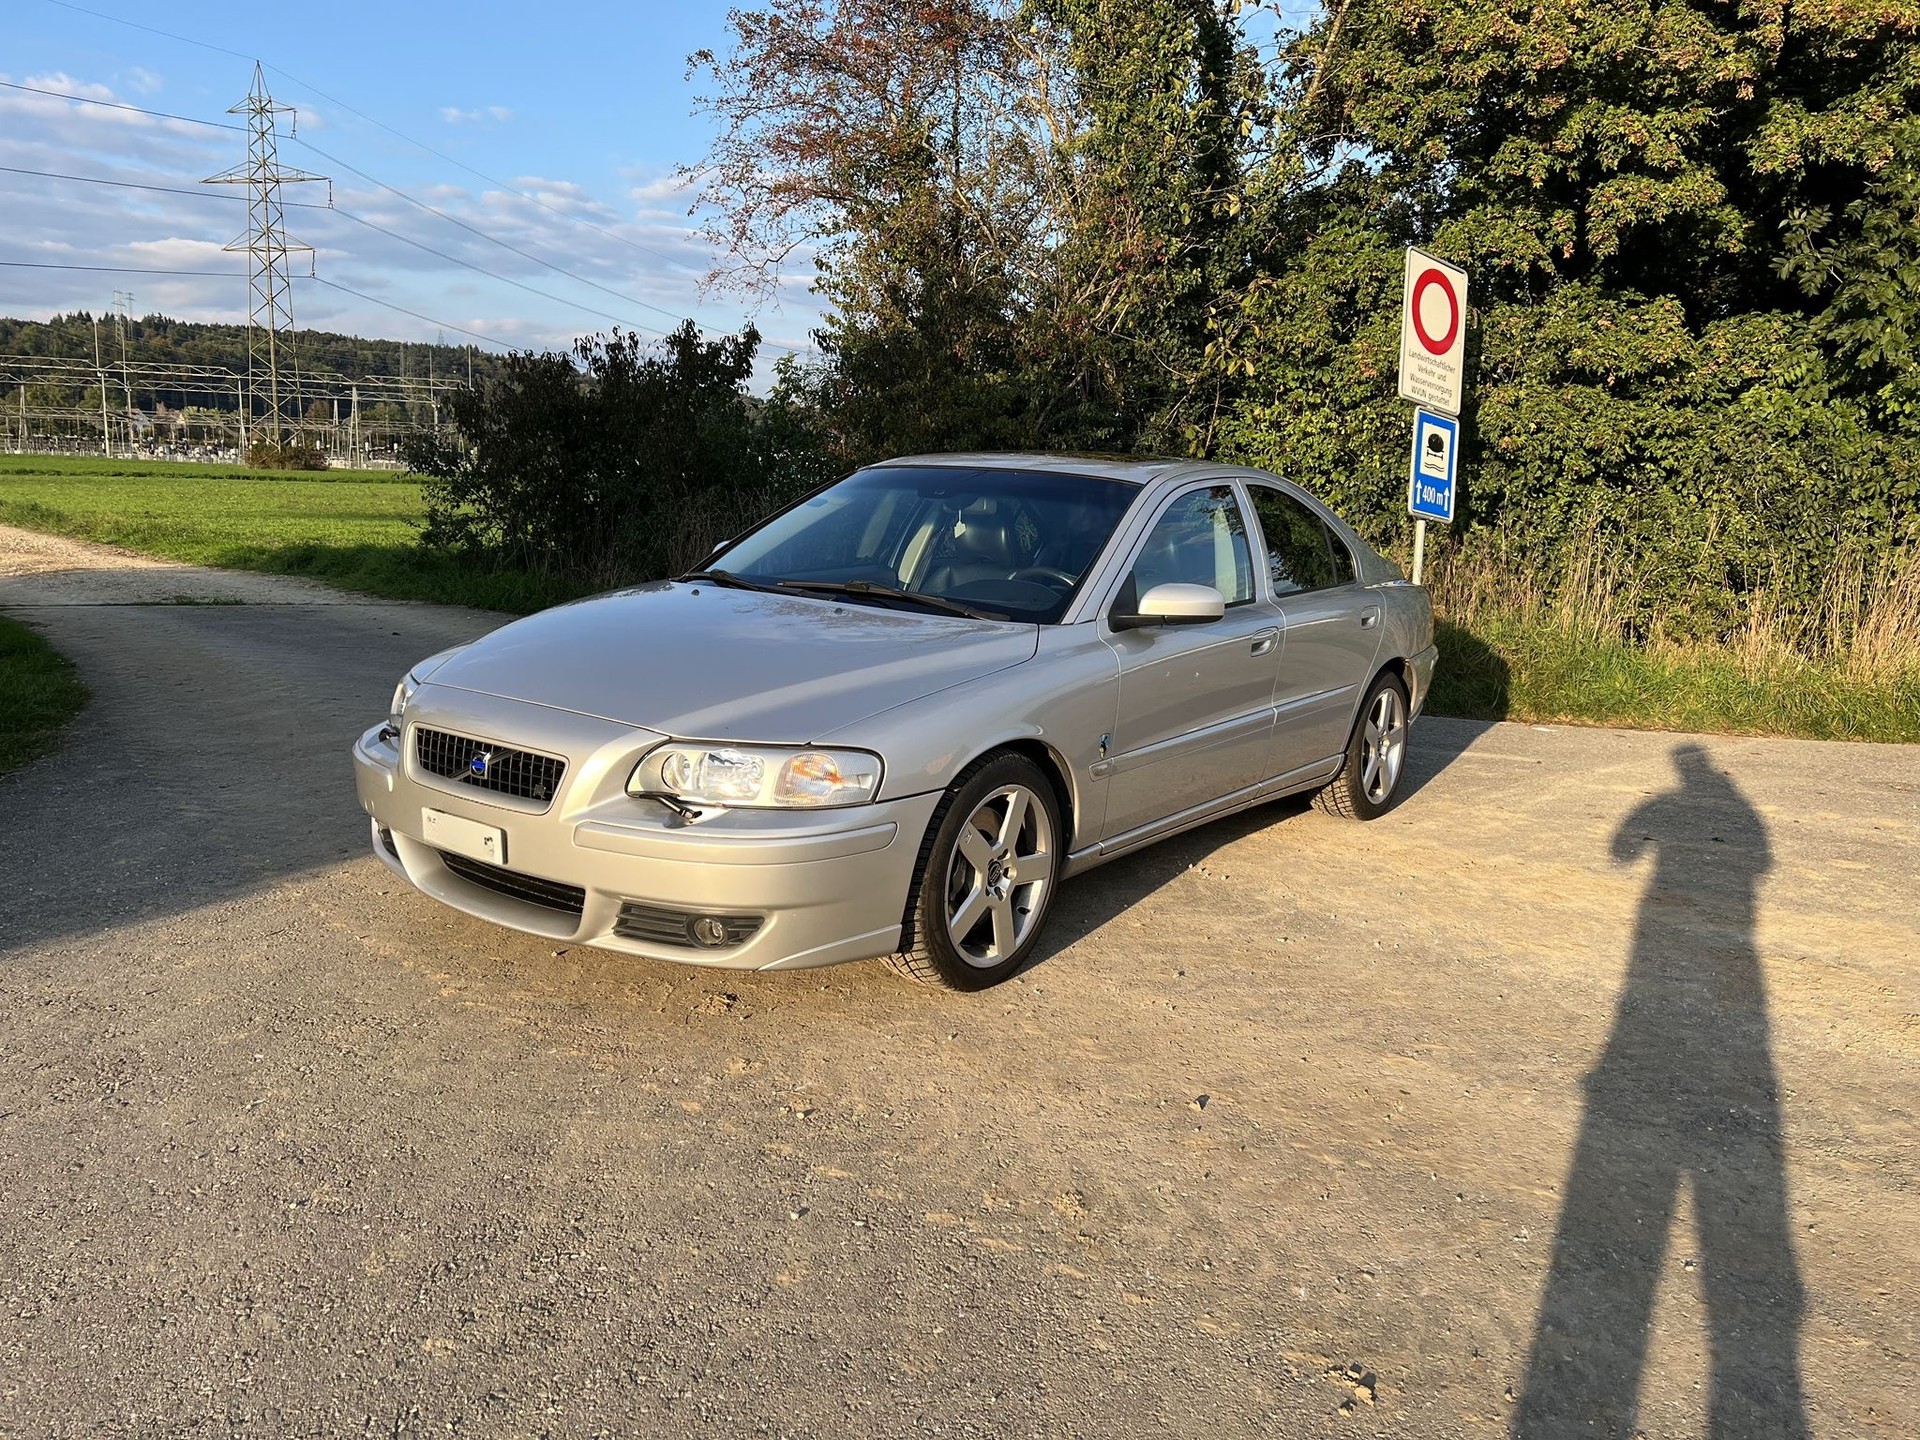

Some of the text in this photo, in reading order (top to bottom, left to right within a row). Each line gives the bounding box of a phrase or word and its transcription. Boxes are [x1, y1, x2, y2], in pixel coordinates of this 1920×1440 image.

[1408, 350, 1456, 373] Landwirtschaftlicher
[1417, 364, 1447, 382] Verkehr und
[1409, 372, 1453, 398] Wasserversorgung
[1428, 393, 1449, 406] gestattet
[1422, 485, 1443, 505] 400 m
